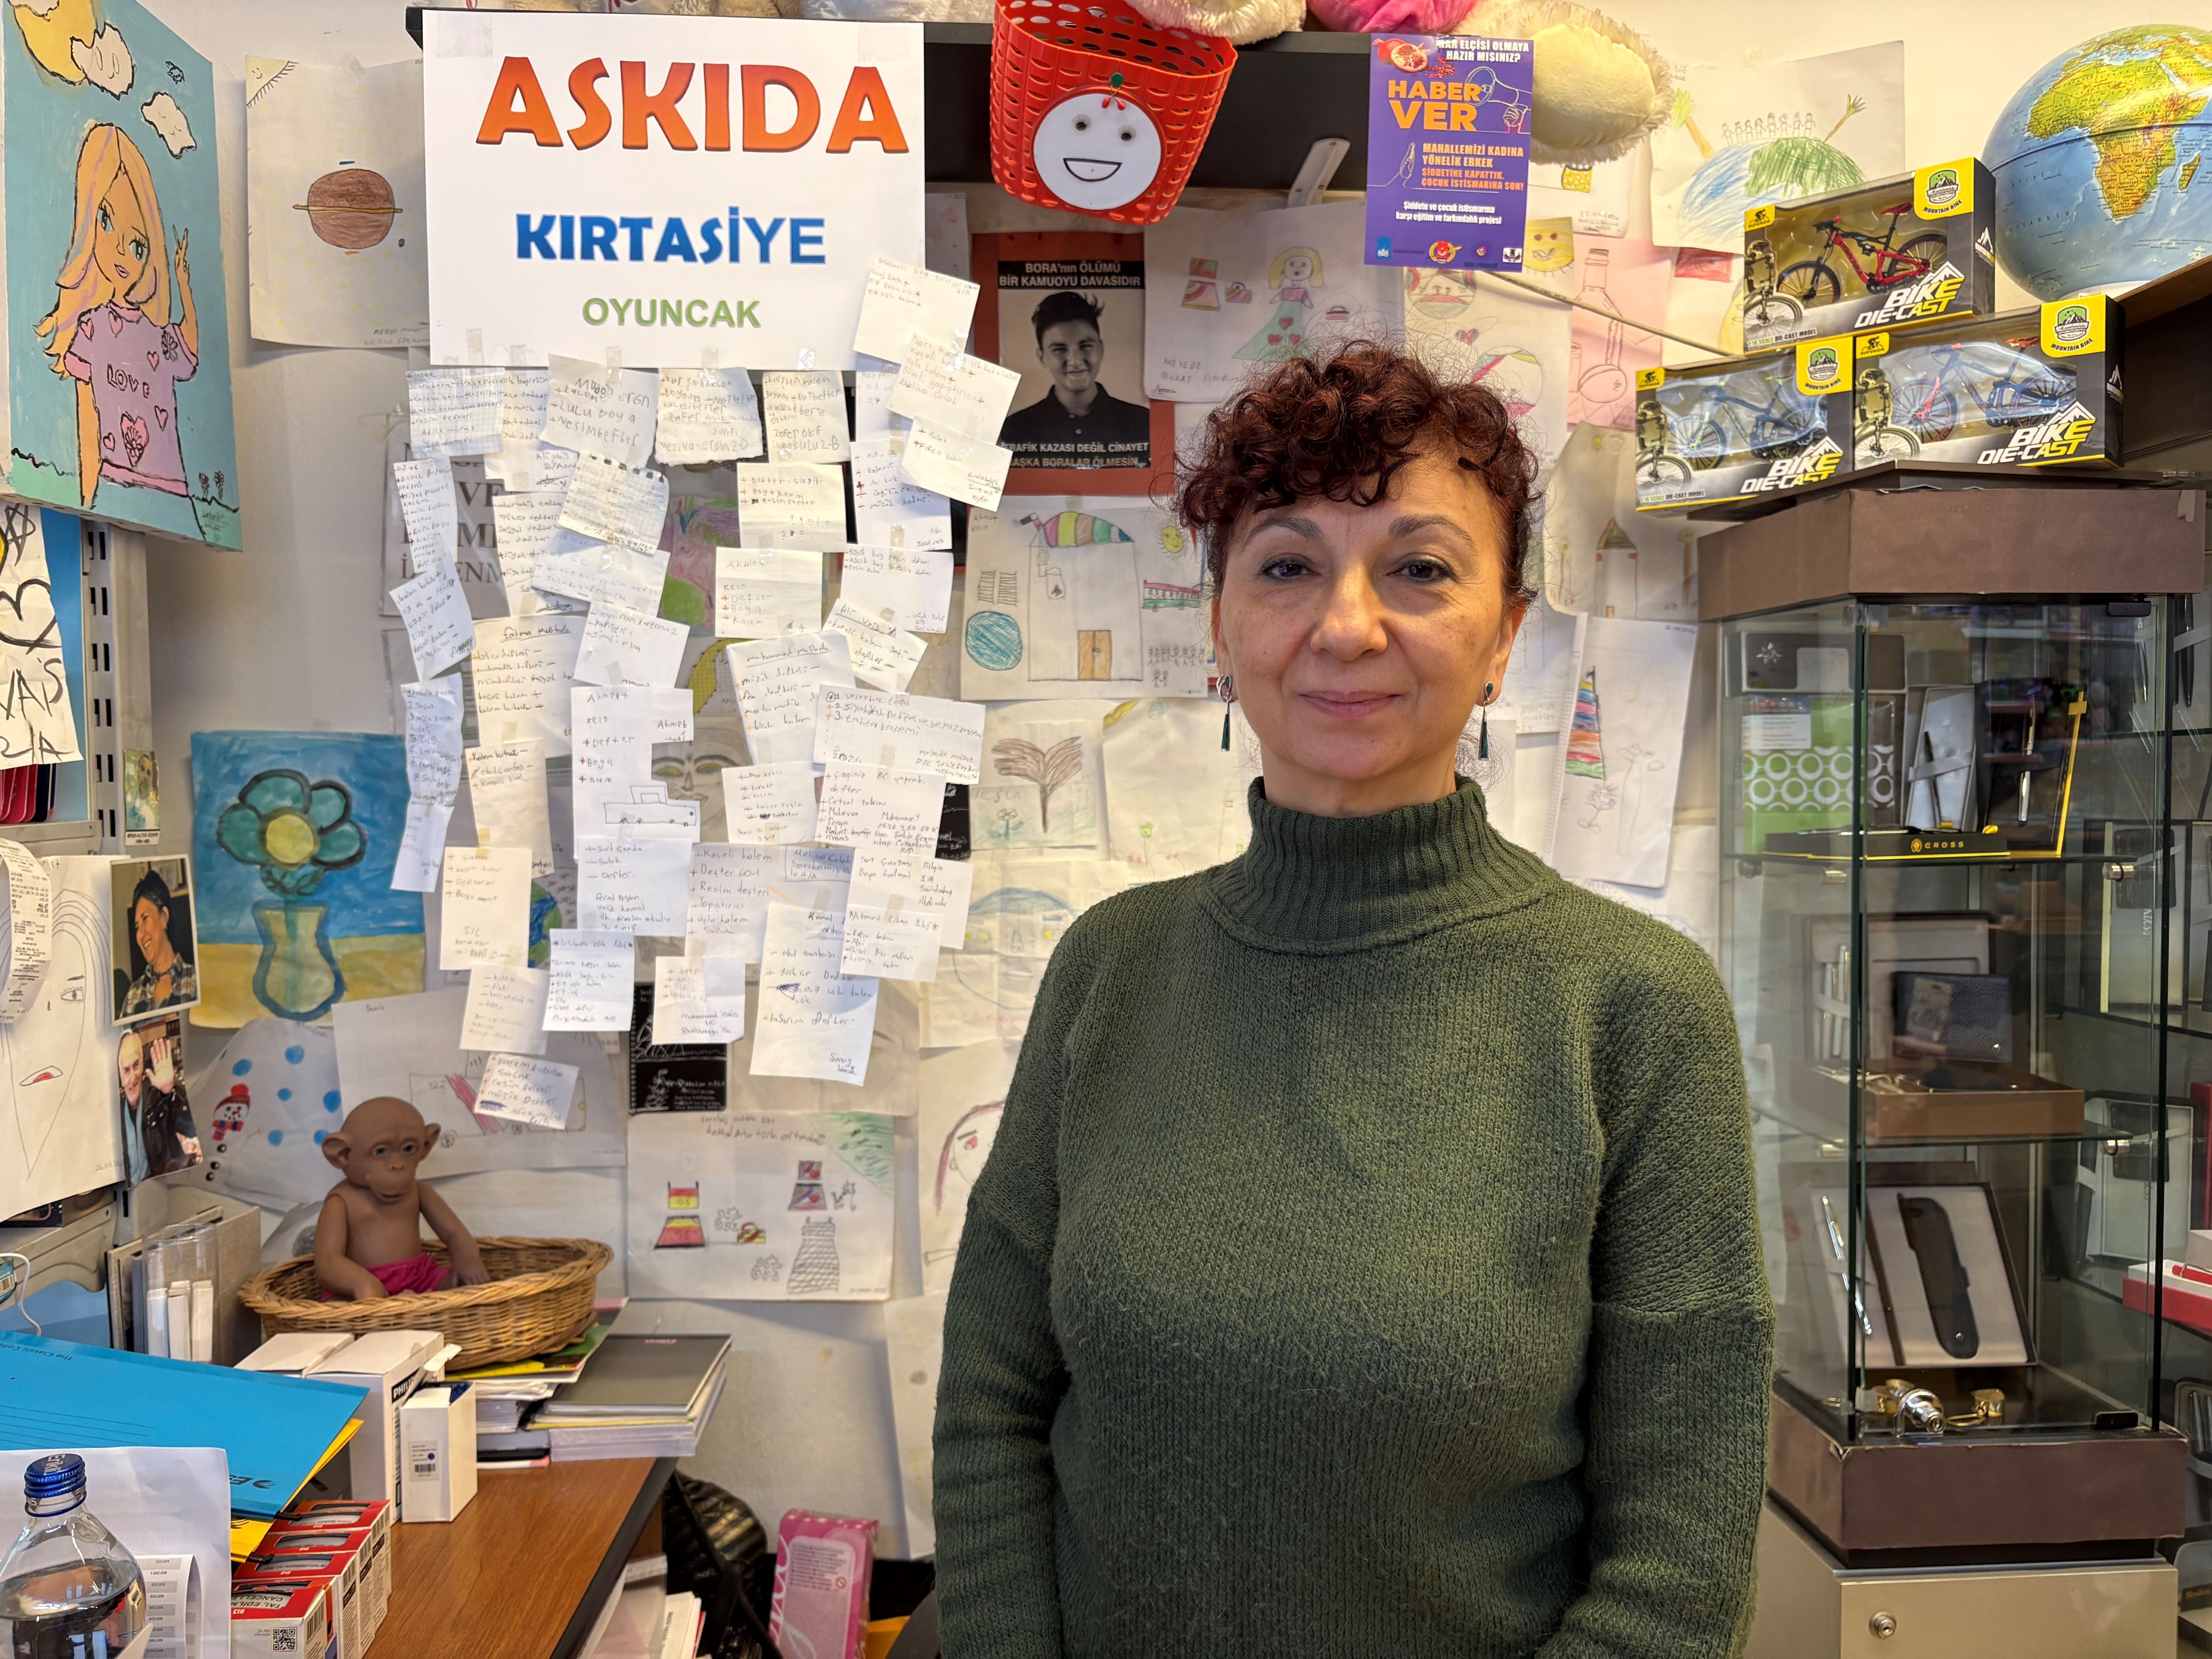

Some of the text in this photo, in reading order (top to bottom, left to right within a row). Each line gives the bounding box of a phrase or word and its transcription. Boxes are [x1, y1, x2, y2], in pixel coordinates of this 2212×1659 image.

[1460, 39, 1490, 51] ELÇİSİ
[1493, 42, 1529, 52] OLMAYA
[1446, 51, 1520, 63] HAZIR MISINIZ?
[1389, 80, 1481, 101] HABER
[476, 56, 910, 154] ASKIDA
[1389, 100, 1477, 131] VER
[1423, 143, 1523, 157] MAHALLEMİZİ KADINA
[1423, 155, 1493, 168] YÖNELİK ERKEK
[1422, 168, 1462, 178] ŞİDDETİNE
[1422, 178, 1448, 188] ÇOCUK
[1451, 179, 1502, 189] İSTİSMARINA
[1404, 201, 1428, 211] Şiddete
[1438, 203, 1458, 212] çocuk
[1950, 200, 1962, 209] BIKE
[1396, 212, 1412, 221] karşı
[1413, 212, 1434, 222] eğitim
[1478, 216, 1502, 225] projesi
[516, 206, 826, 265] KIRTASİYE
[1079, 261, 1120, 272] ÖLÜMÜ
[999, 275, 1140, 286] BİR KAMUOYU DAVASIDIR
[1884, 276, 1965, 310] BIKE
[583, 296, 760, 328] OYUNCAK
[1854, 296, 1955, 329] DIE-CAST
[2081, 338, 2094, 348] BIKE
[107, 364, 150, 398] LOVE
[2009, 418, 2095, 448] BIKE
[1040, 444, 1075, 452] KAZASI
[1077, 443, 1106, 453] DEĞİL
[1108, 442, 1149, 451] CİNAYET
[1977, 440, 2085, 465] DIE-CAST
[1009, 456, 1138, 468] AŞKA BORALAR ÖLMESİN
[1768, 452, 1843, 477] BIKE
[1740, 470, 1835, 494] DIE-CAST
[1925, 840, 1964, 849] CROSS
[21, 1347, 54, 1357] Classic
[393, 1375, 415, 1399] PHILIP
